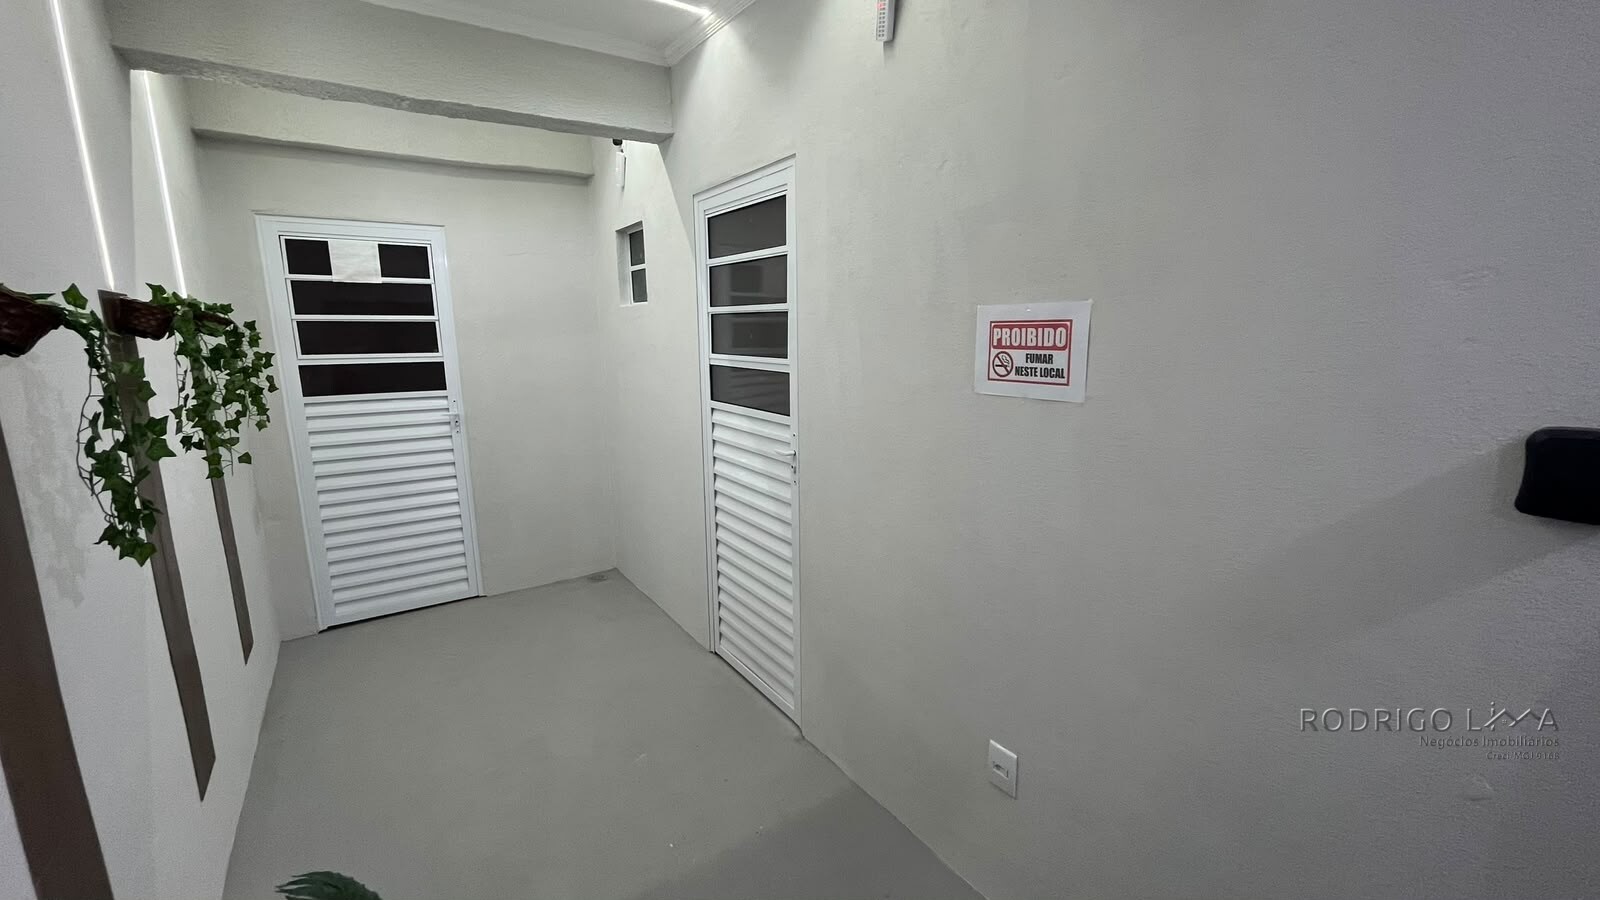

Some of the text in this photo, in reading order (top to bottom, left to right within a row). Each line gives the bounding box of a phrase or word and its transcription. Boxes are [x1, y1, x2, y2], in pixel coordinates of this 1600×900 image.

[992, 327, 1067, 348] PROIBIDO
[1025, 353, 1054, 365] FUMAR
[1014, 366, 1066, 379] NESTE LOCAL
